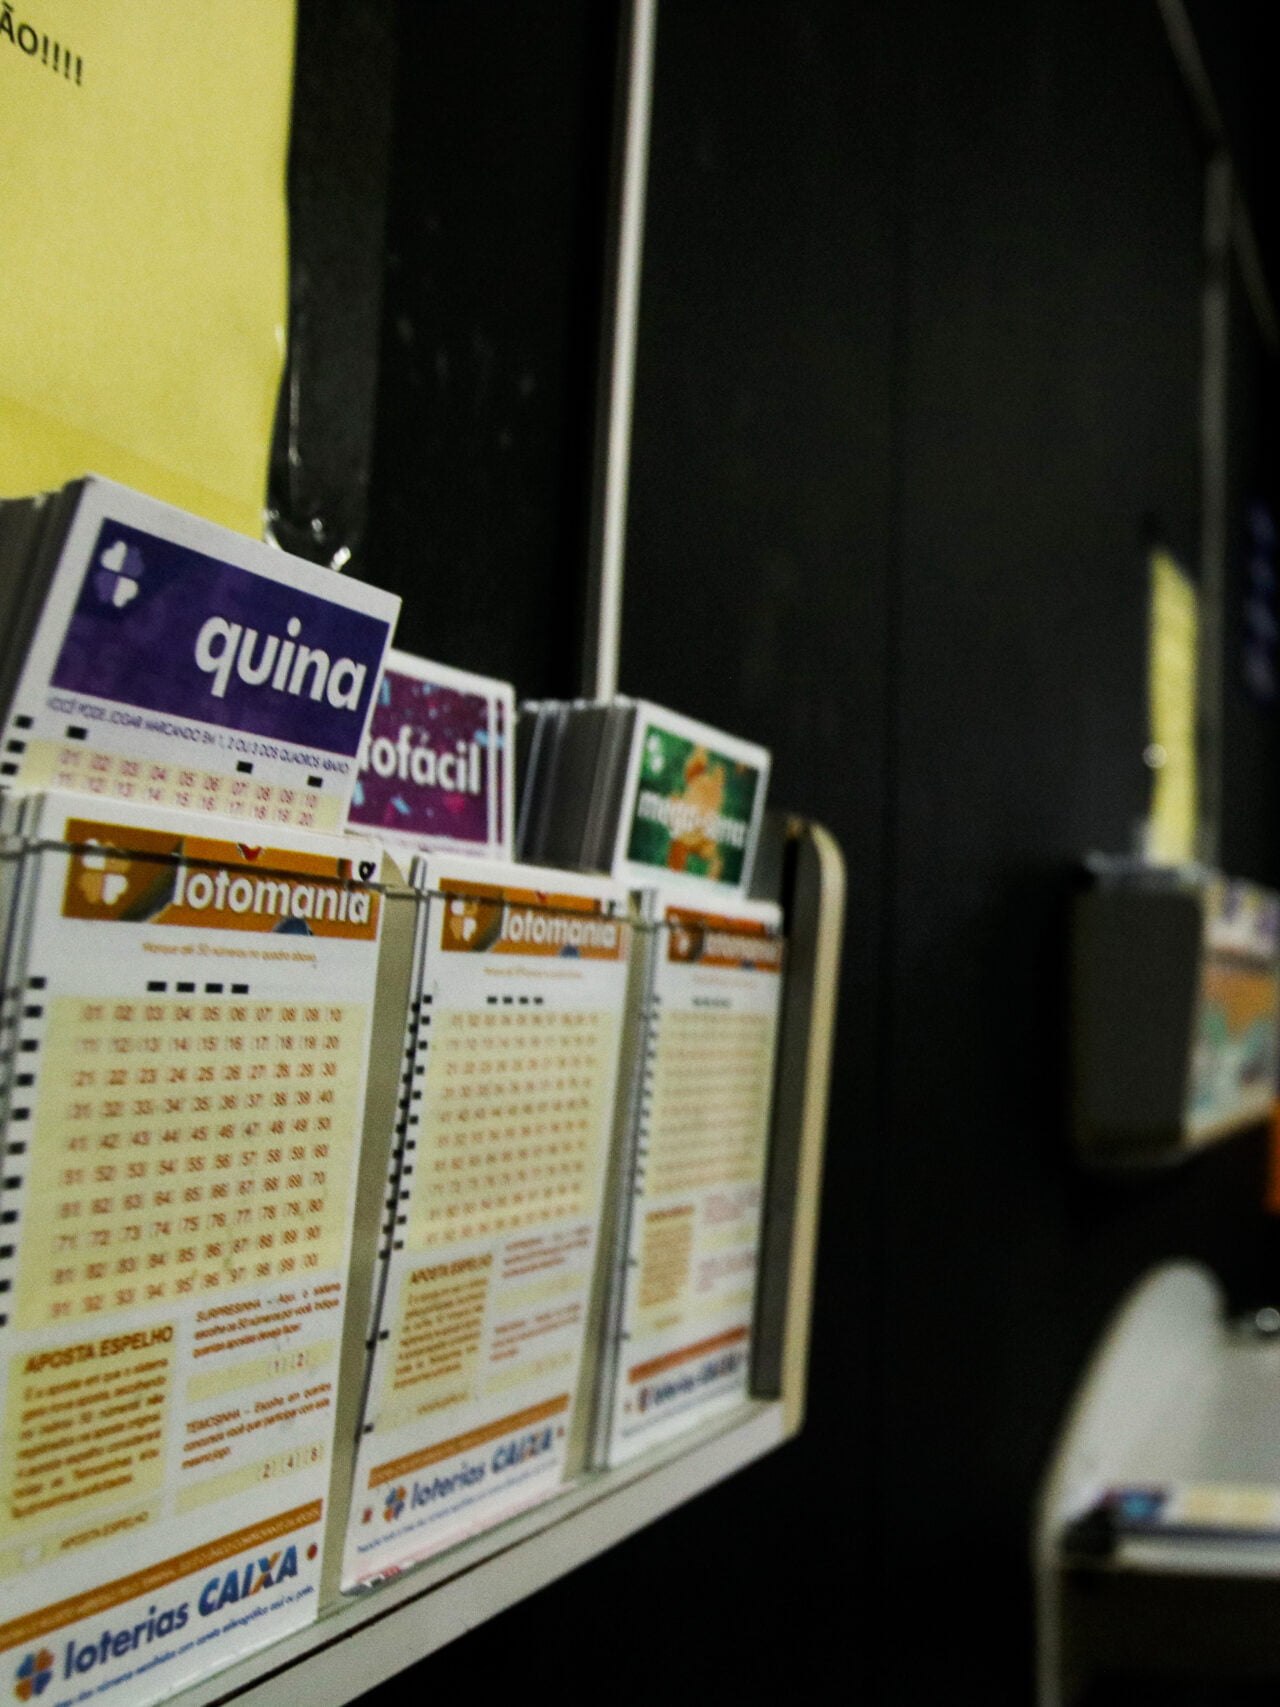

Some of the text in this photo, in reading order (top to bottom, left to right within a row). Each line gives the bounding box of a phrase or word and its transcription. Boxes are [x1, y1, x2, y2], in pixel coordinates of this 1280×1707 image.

[194, 615, 367, 712] quina
[172, 857, 371, 924] lotomania
[500, 907, 618, 949] lotomania
[100, 1326, 174, 1358] ESPELHO
[63, 1600, 189, 1681] loterias
[199, 1545, 298, 1617] CAIXA
